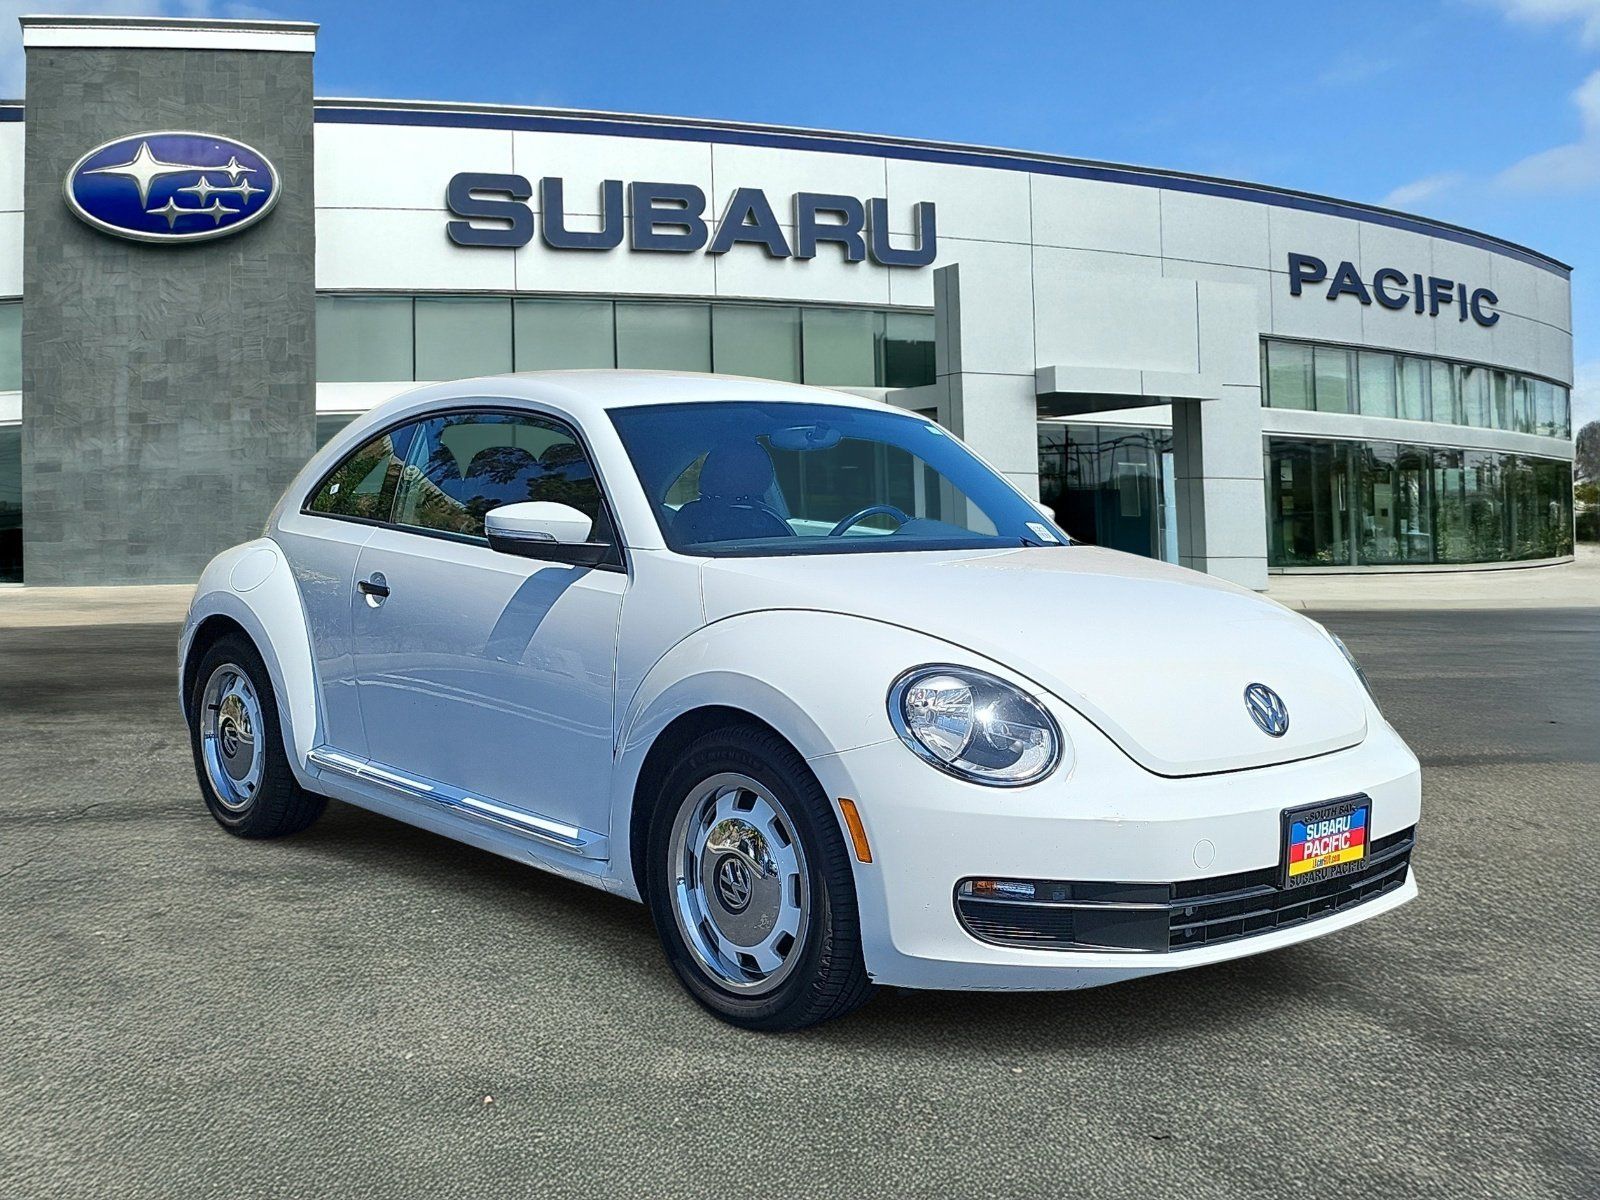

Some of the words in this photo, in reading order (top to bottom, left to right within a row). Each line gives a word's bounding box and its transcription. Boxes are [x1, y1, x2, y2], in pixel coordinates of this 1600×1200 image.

[447, 172, 937, 267] SUBARU
[1288, 252, 1500, 327] PACIFIC
[1309, 806, 1337, 821] SOUTH
[1339, 803, 1355, 815] BAY
[1306, 815, 1351, 840] SUBARU
[1303, 832, 1351, 860] PACIFIC
[1289, 869, 1328, 888] SUBARU
[1330, 859, 1366, 878] PACIFIC
